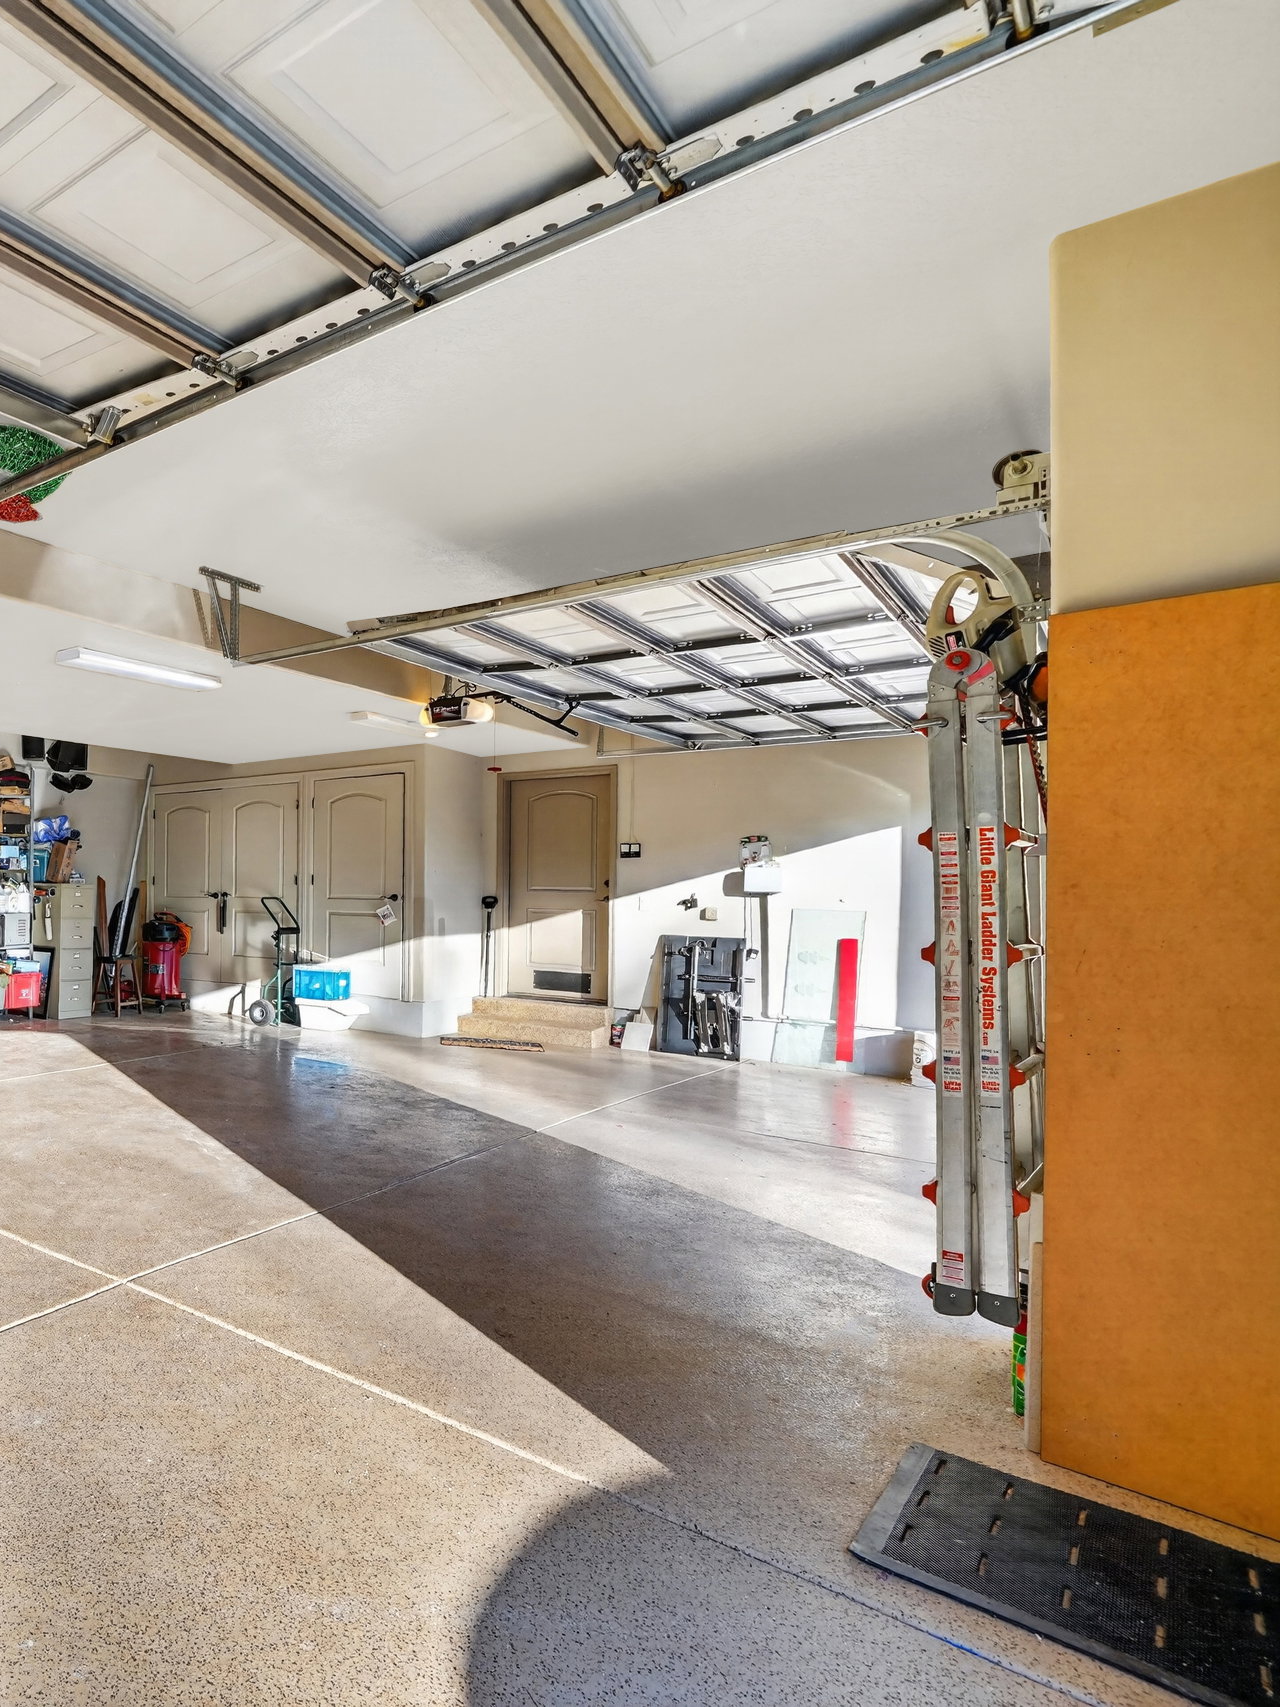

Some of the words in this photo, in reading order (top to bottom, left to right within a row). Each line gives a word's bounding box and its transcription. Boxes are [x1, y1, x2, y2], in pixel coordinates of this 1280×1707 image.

[979, 827, 996, 866] Little
[980, 869, 997, 907] Giant
[981, 911, 998, 962] Ladder
